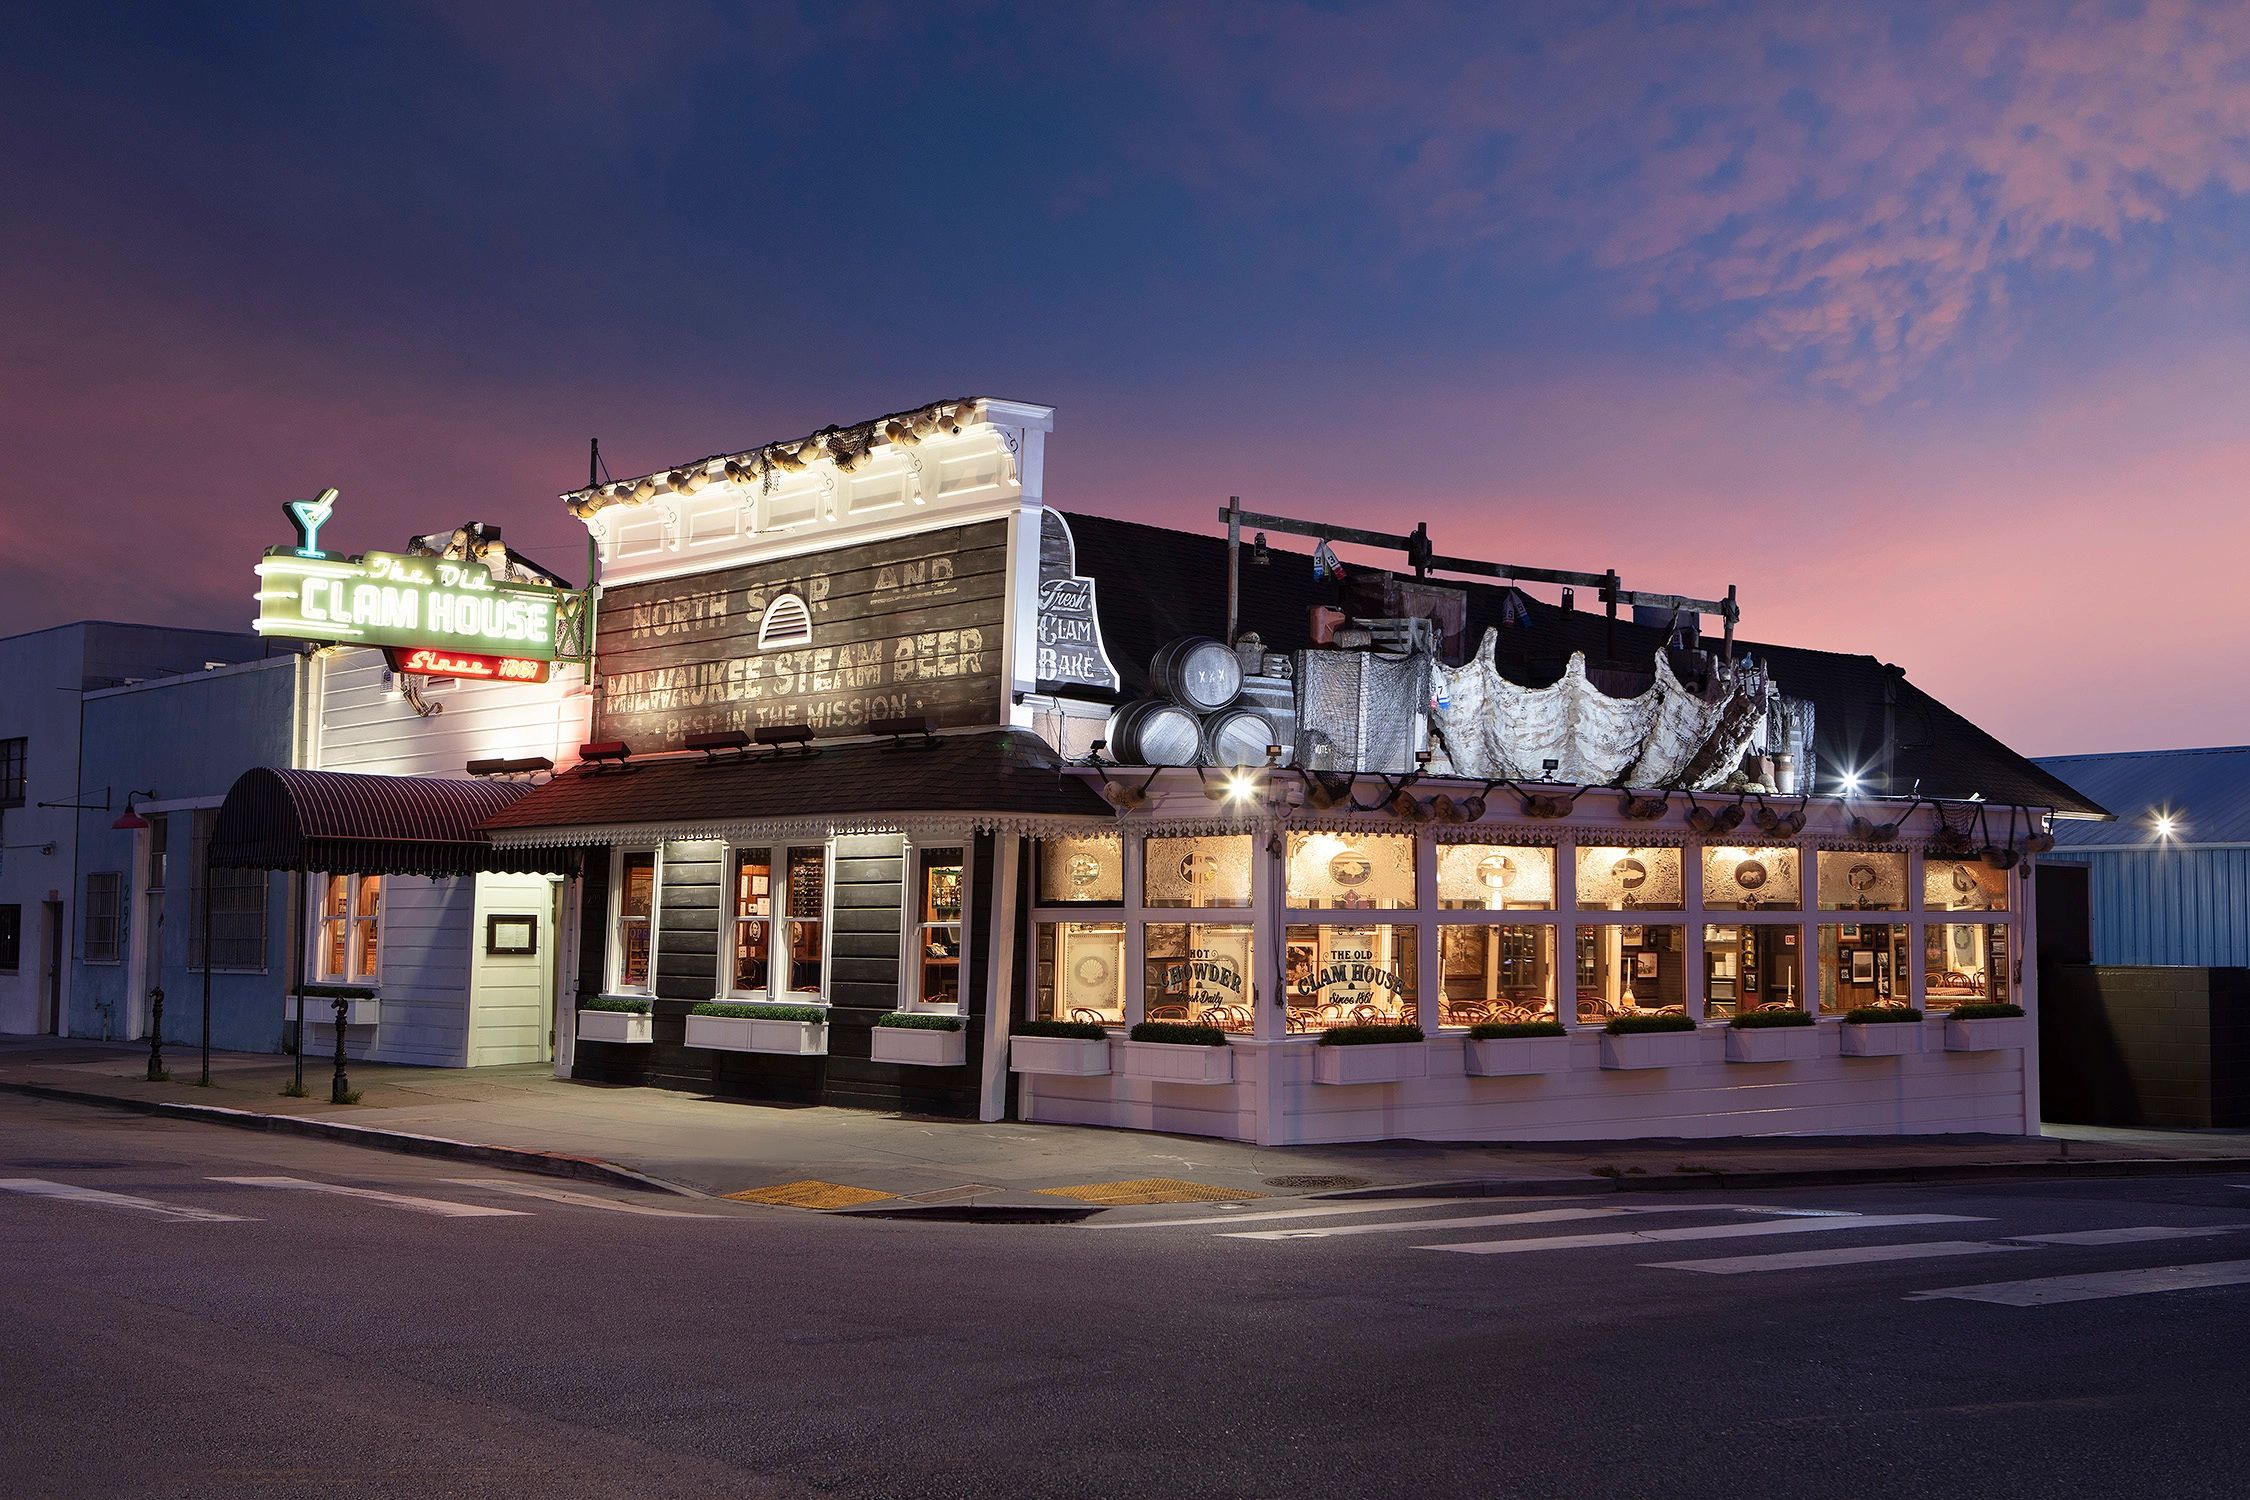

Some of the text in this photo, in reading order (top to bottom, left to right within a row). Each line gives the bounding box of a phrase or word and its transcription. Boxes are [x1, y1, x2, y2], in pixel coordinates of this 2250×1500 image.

[367, 558, 495, 591] The Old
[300, 578, 548, 642] CLAM HOUSE
[632, 589, 728, 639] NORTH
[872, 558, 954, 597] AND
[1038, 579, 1088, 611] Fresh
[1037, 613, 1092, 645] CLAM
[404, 651, 493, 675] Since
[607, 628, 983, 713] MILWAUKEE STEAM BEER
[1037, 648, 1095, 682] BAKE
[807, 693, 908, 729] MISSION
[1189, 949, 1210, 958] HOT
[1331, 951, 1373, 960] THE OLD
[1160, 962, 1242, 993] CHOWDER
[1297, 964, 1405, 996] CLAM HOUSE
[1200, 990, 1223, 1009] Daily
[1329, 992, 1355, 1004] Since
